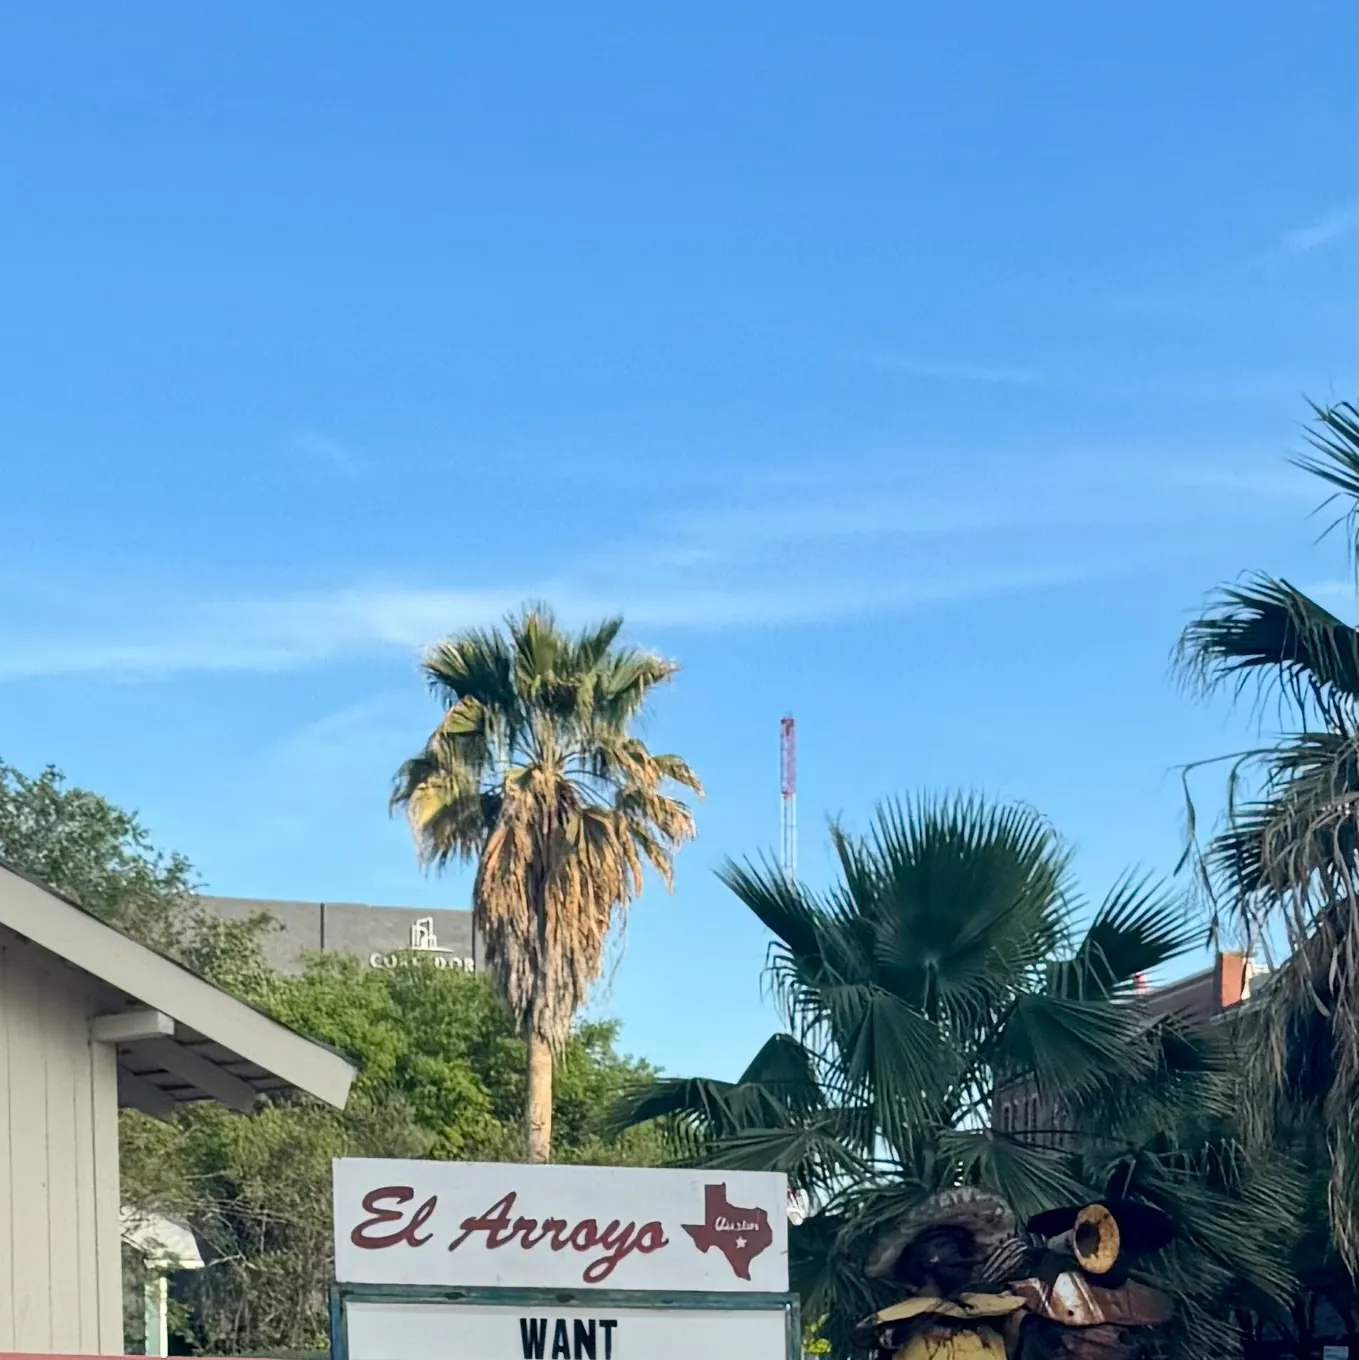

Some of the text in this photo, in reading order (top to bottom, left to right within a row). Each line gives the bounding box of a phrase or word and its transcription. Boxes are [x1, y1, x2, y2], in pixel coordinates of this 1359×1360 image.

[350, 1185, 670, 1284] El Arroyo
[715, 1216, 759, 1231] Austin
[520, 1318, 617, 1360] WANT
